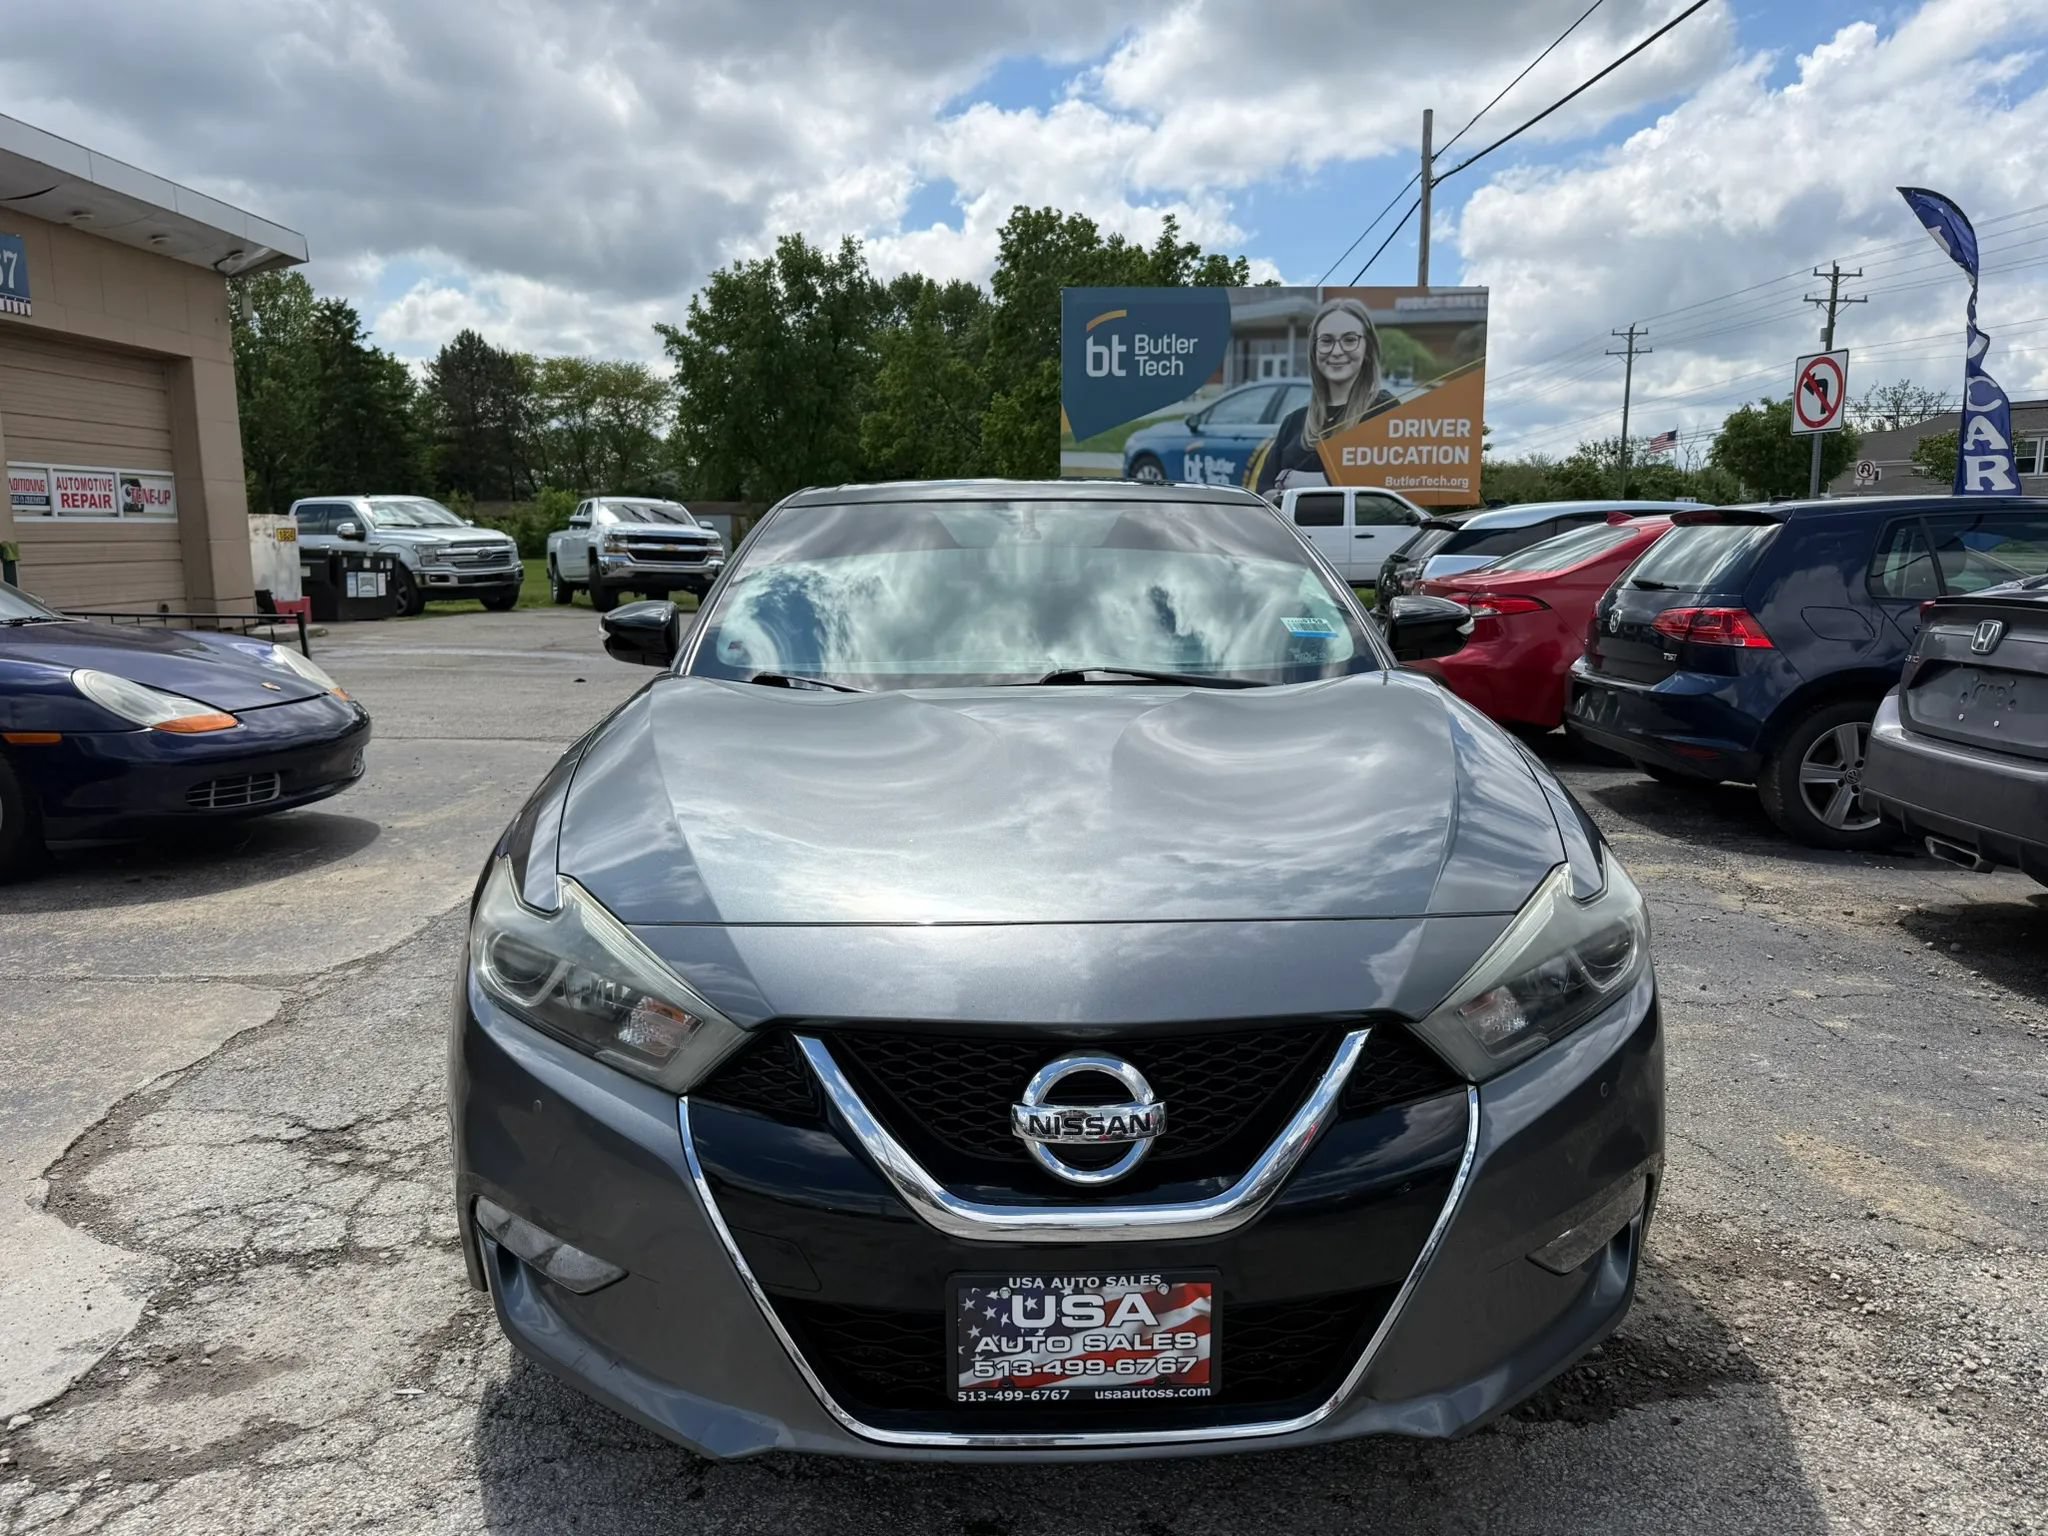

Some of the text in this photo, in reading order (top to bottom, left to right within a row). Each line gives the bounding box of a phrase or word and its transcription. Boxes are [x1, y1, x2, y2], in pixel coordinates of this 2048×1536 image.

[0, 249, 18, 289] 7
[1134, 333, 1199, 354] Butler
[1086, 334, 1127, 377] bt
[1134, 355, 1184, 377] Tech
[1388, 418, 1471, 438] DRIVER
[1342, 445, 1470, 466] EDUCATION
[56, 476, 113, 493] AUTOMOTIVE
[1385, 475, 1469, 488] ButlerTech.org
[61, 493, 113, 509] REPAIR
[131, 487, 172, 505] TUNE-UP
[1028, 1113, 1151, 1136] NISSAN
[1008, 1275, 1161, 1289] USA AUTO SALES
[1010, 1292, 1160, 1329] USA
[974, 1332, 1198, 1353] AUTO SALES
[973, 1356, 1199, 1378] 513-499-6767
[957, 1387, 1211, 1402] 513-499-6767 usaautoss.com
